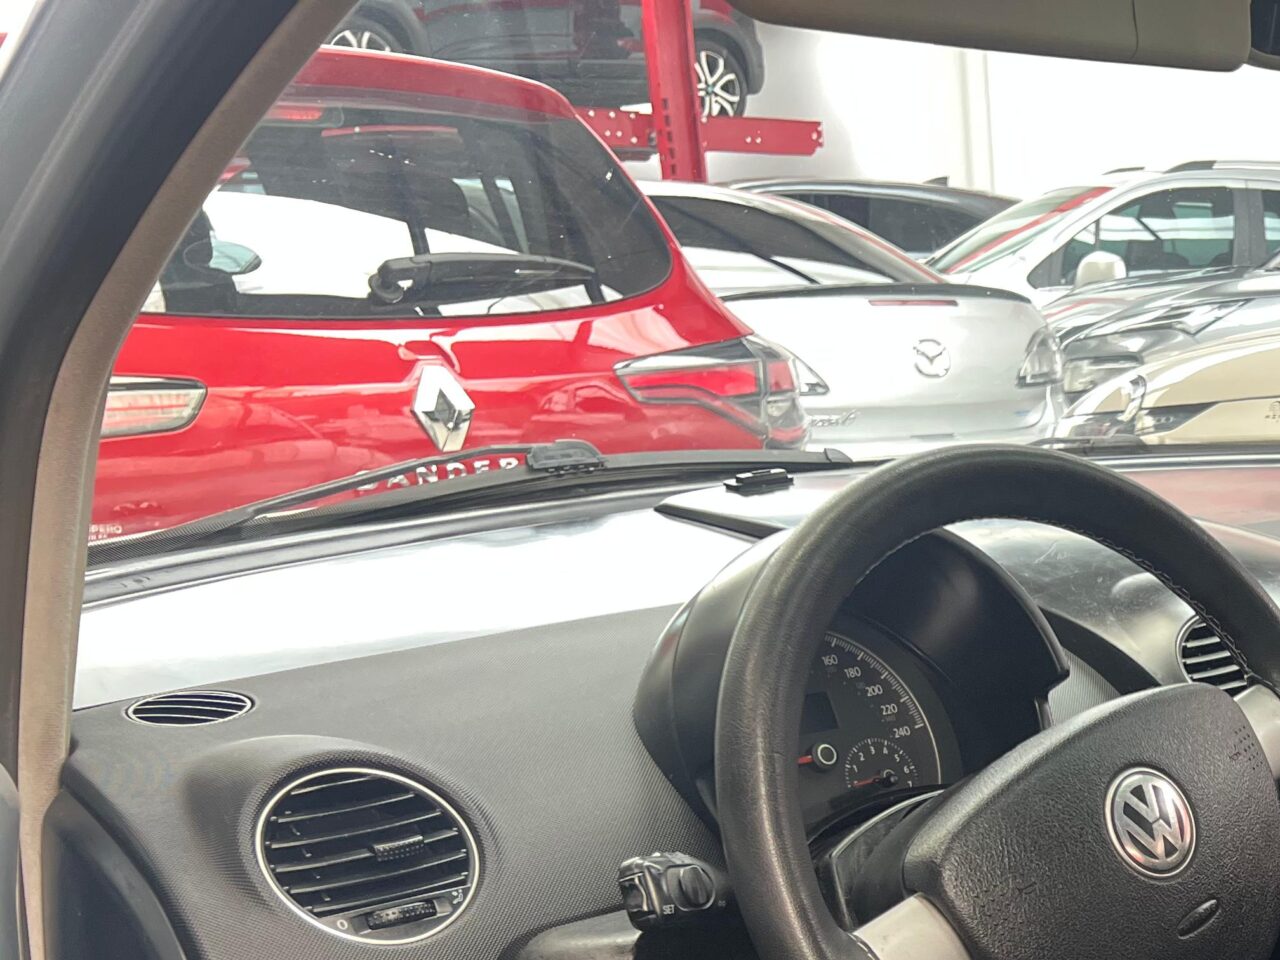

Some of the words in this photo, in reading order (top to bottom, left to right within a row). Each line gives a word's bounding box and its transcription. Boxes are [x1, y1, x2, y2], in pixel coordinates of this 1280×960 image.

[821, 654, 839, 666] 160
[843, 666, 862, 679] 180
[865, 684, 884, 697] 200
[880, 703, 898, 716] 220
[893, 725, 911, 739] 240
[662, 904, 675, 915] SET
